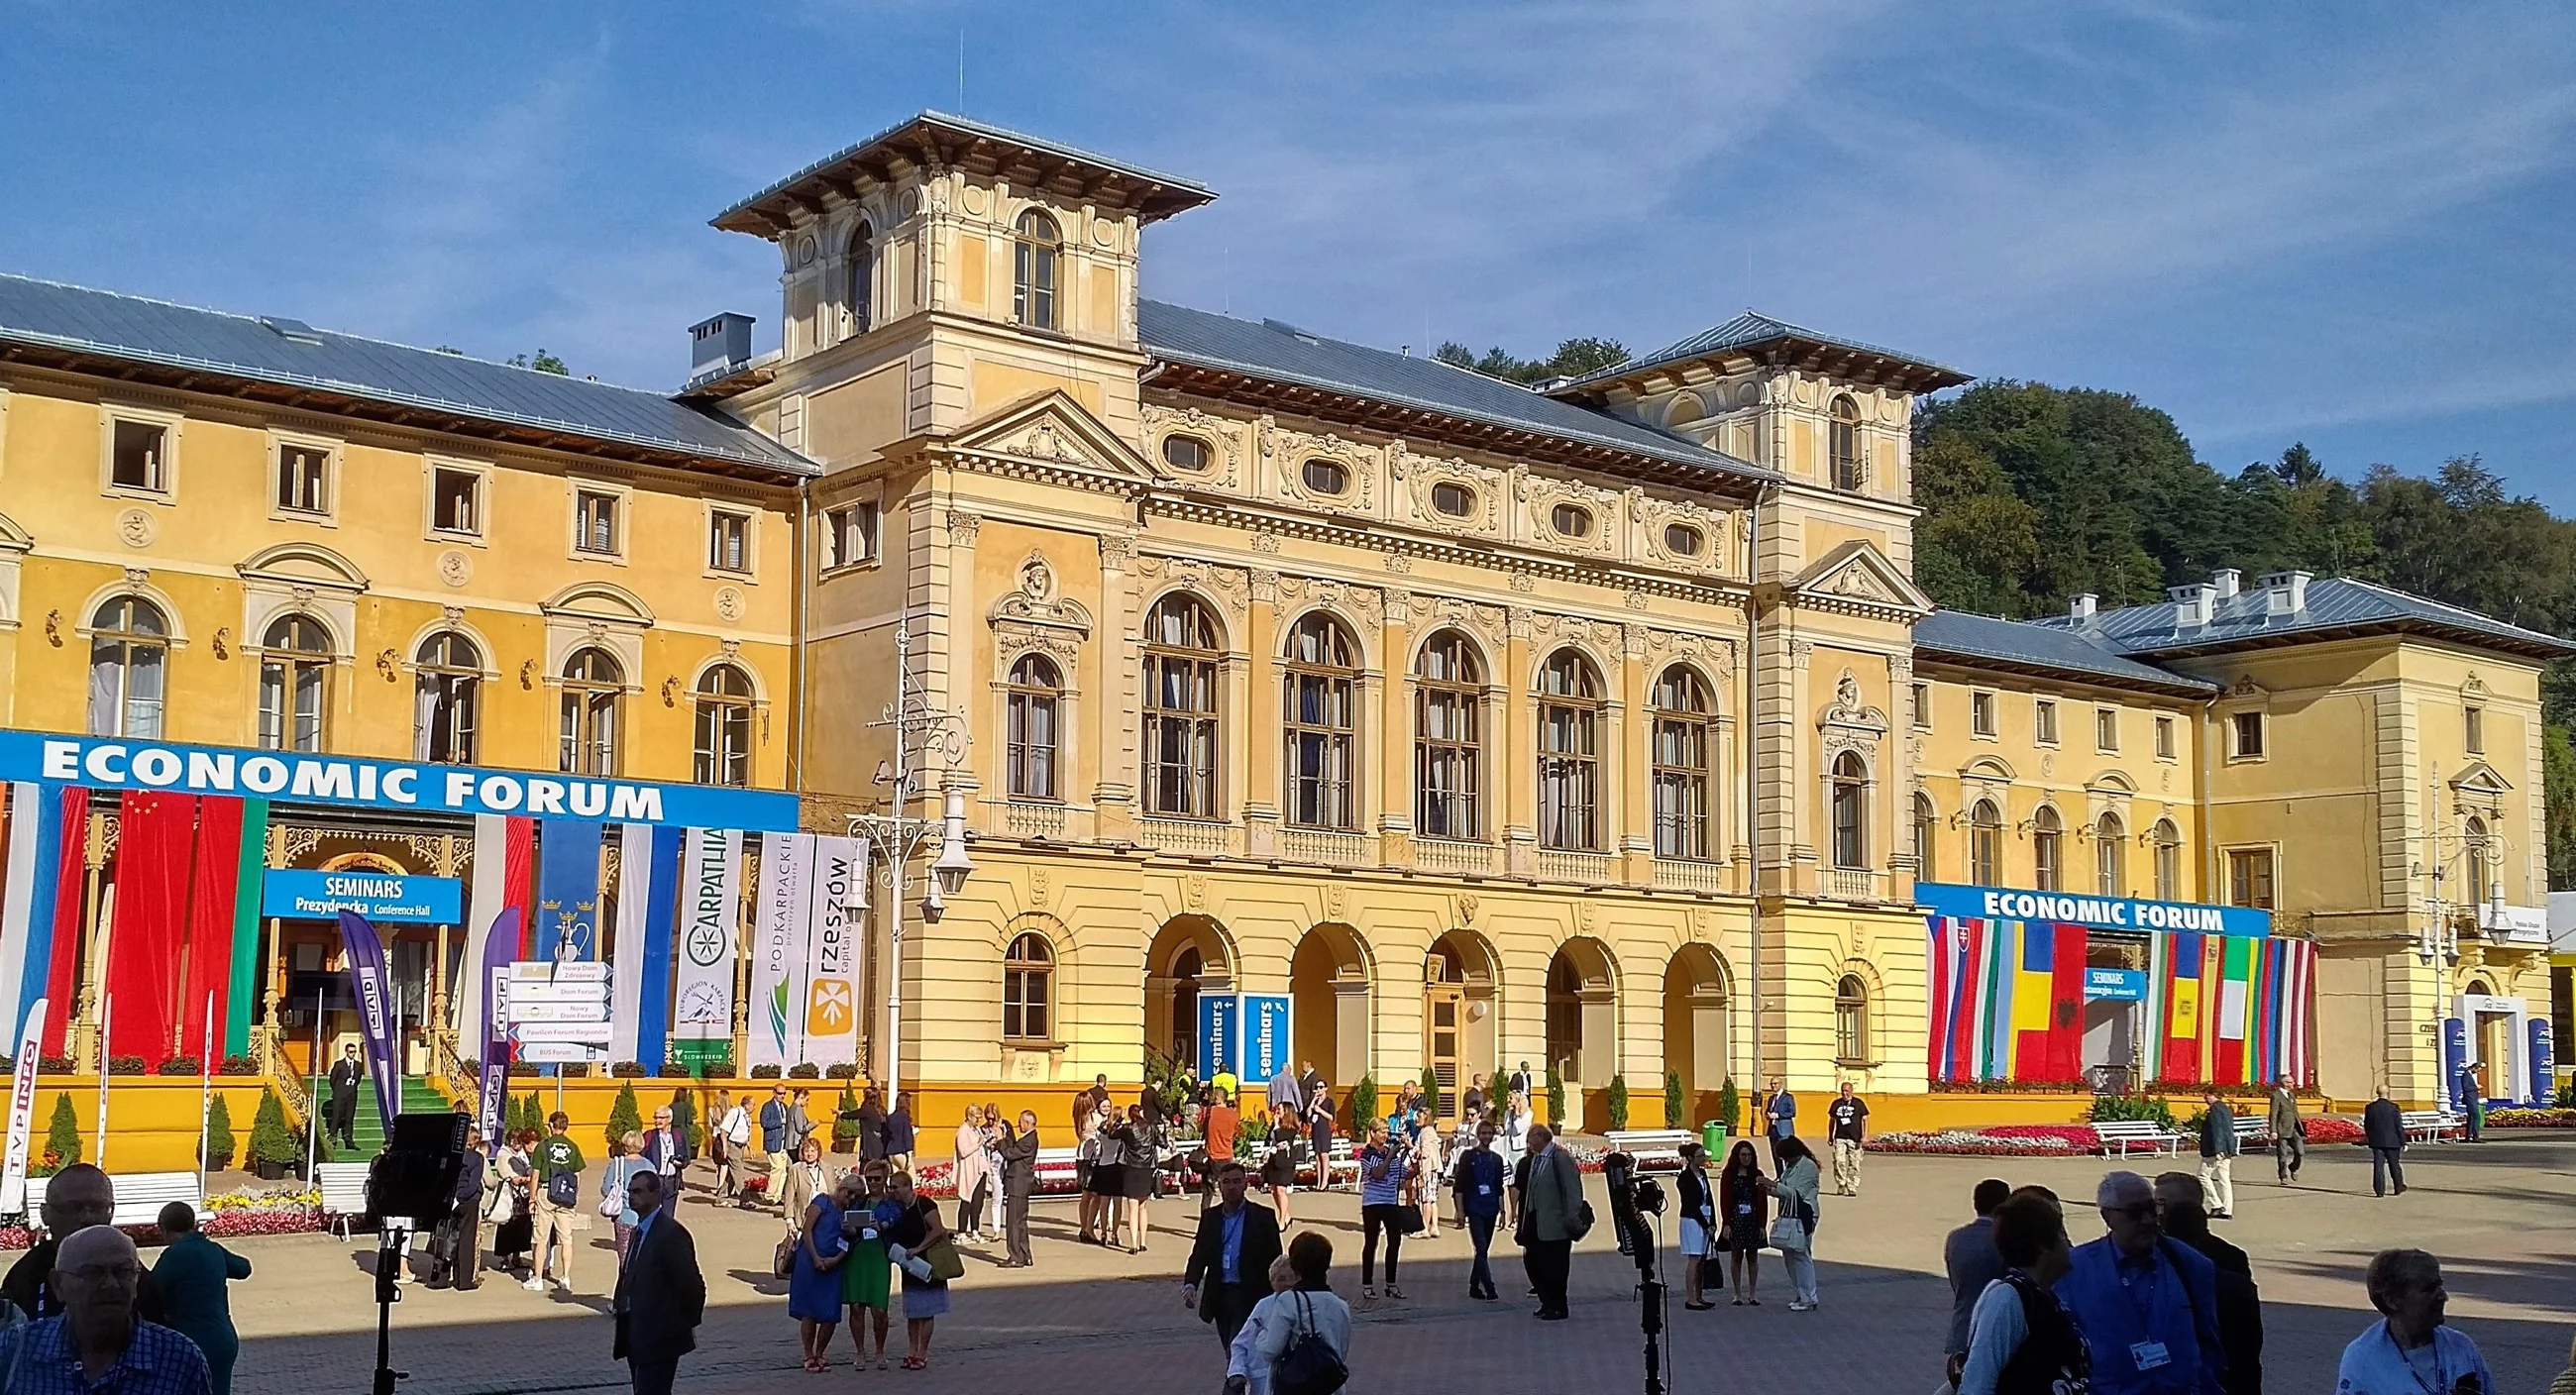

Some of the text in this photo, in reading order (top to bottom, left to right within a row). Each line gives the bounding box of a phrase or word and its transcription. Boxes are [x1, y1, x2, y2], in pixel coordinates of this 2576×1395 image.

[43, 740, 664, 821] ECONOMIC FORUM
[295, 897, 431, 916] Prezydencka Conference Hall
[325, 877, 403, 899] SEMINARS
[770, 835, 792, 971] PODKARPACKIE
[820, 857, 848, 973] rzeszów
[1984, 891, 2224, 931] ECONOMIC FORUM
[840, 936, 852, 974] capital
[1431, 966, 1437, 975] 2
[1210, 1001, 1223, 1074] seminars
[1256, 1001, 1272, 1077] seminars
[10, 1045, 36, 1173] TVP INFO
